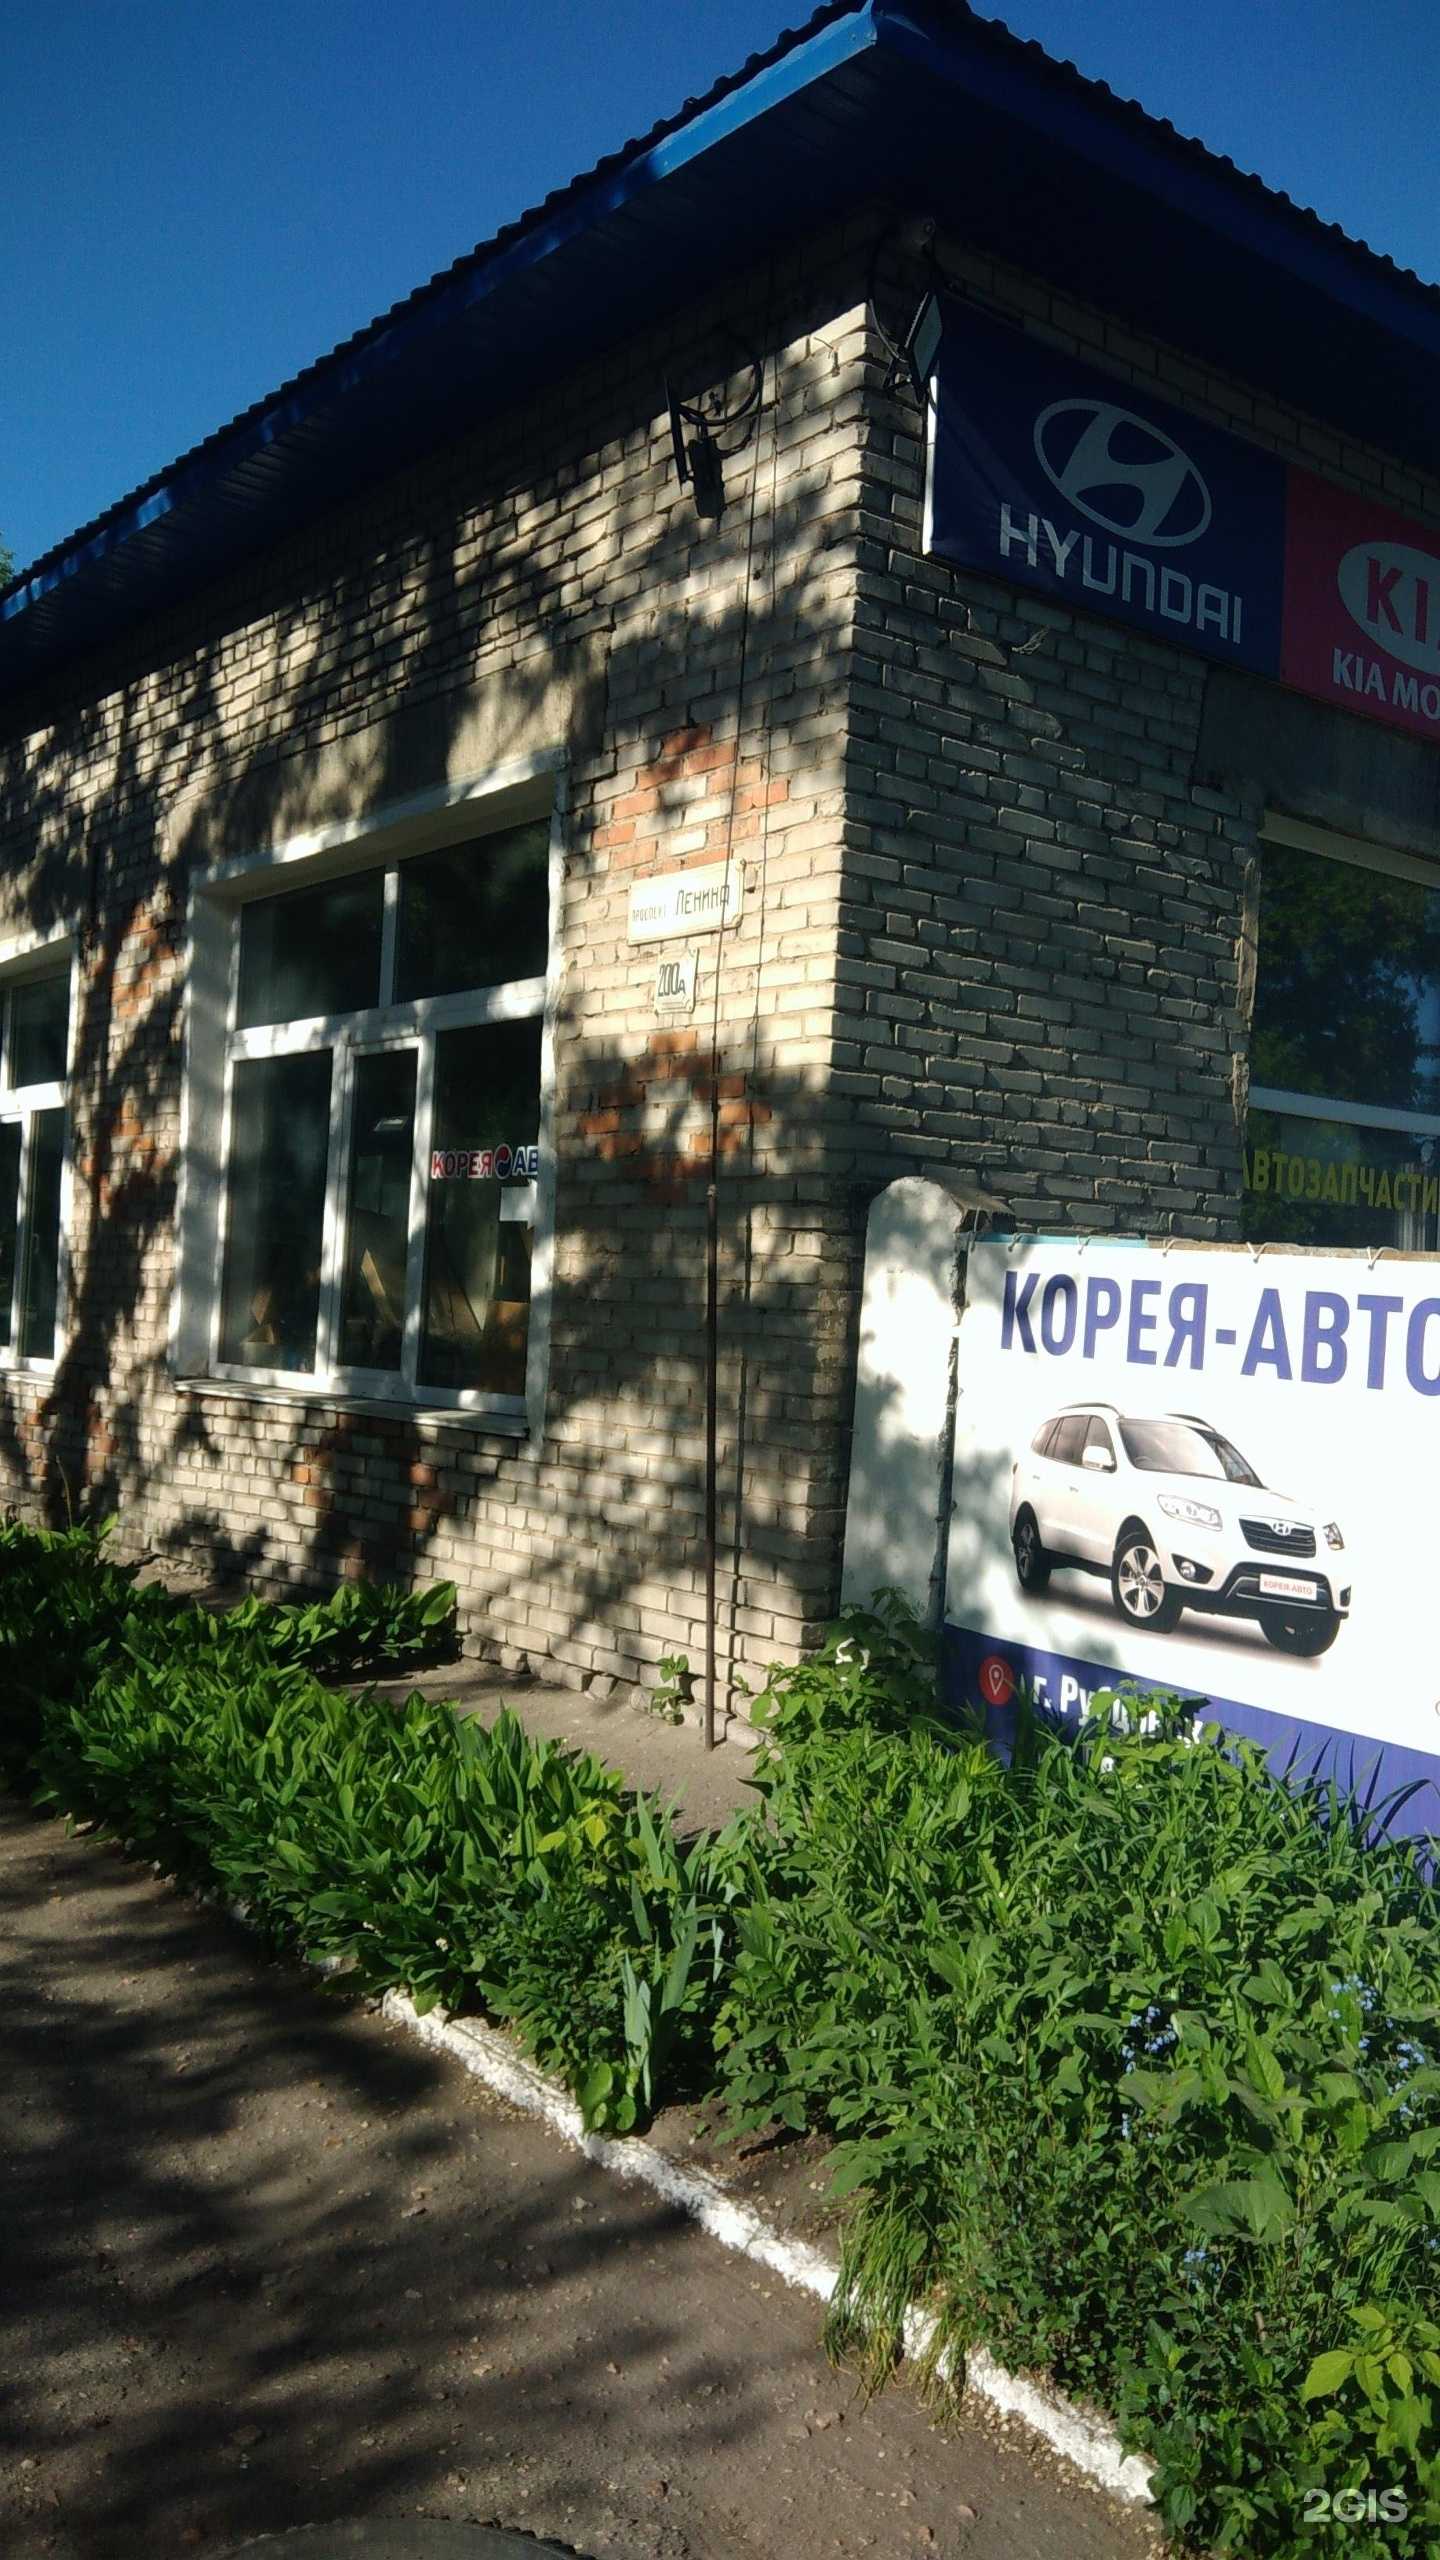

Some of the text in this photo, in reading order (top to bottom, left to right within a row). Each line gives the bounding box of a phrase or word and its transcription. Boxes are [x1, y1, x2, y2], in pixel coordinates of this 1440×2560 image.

[999, 503, 1242, 643] HYUNDAI
[1366, 556, 1440, 652] KI
[1332, 647, 1387, 702] KIA
[675, 884, 730, 916] ЛЕНИНА
[431, 1150, 493, 1179] КОРЕЯ
[1001, 1270, 1440, 1396] КОРЕЯ-АВТО
